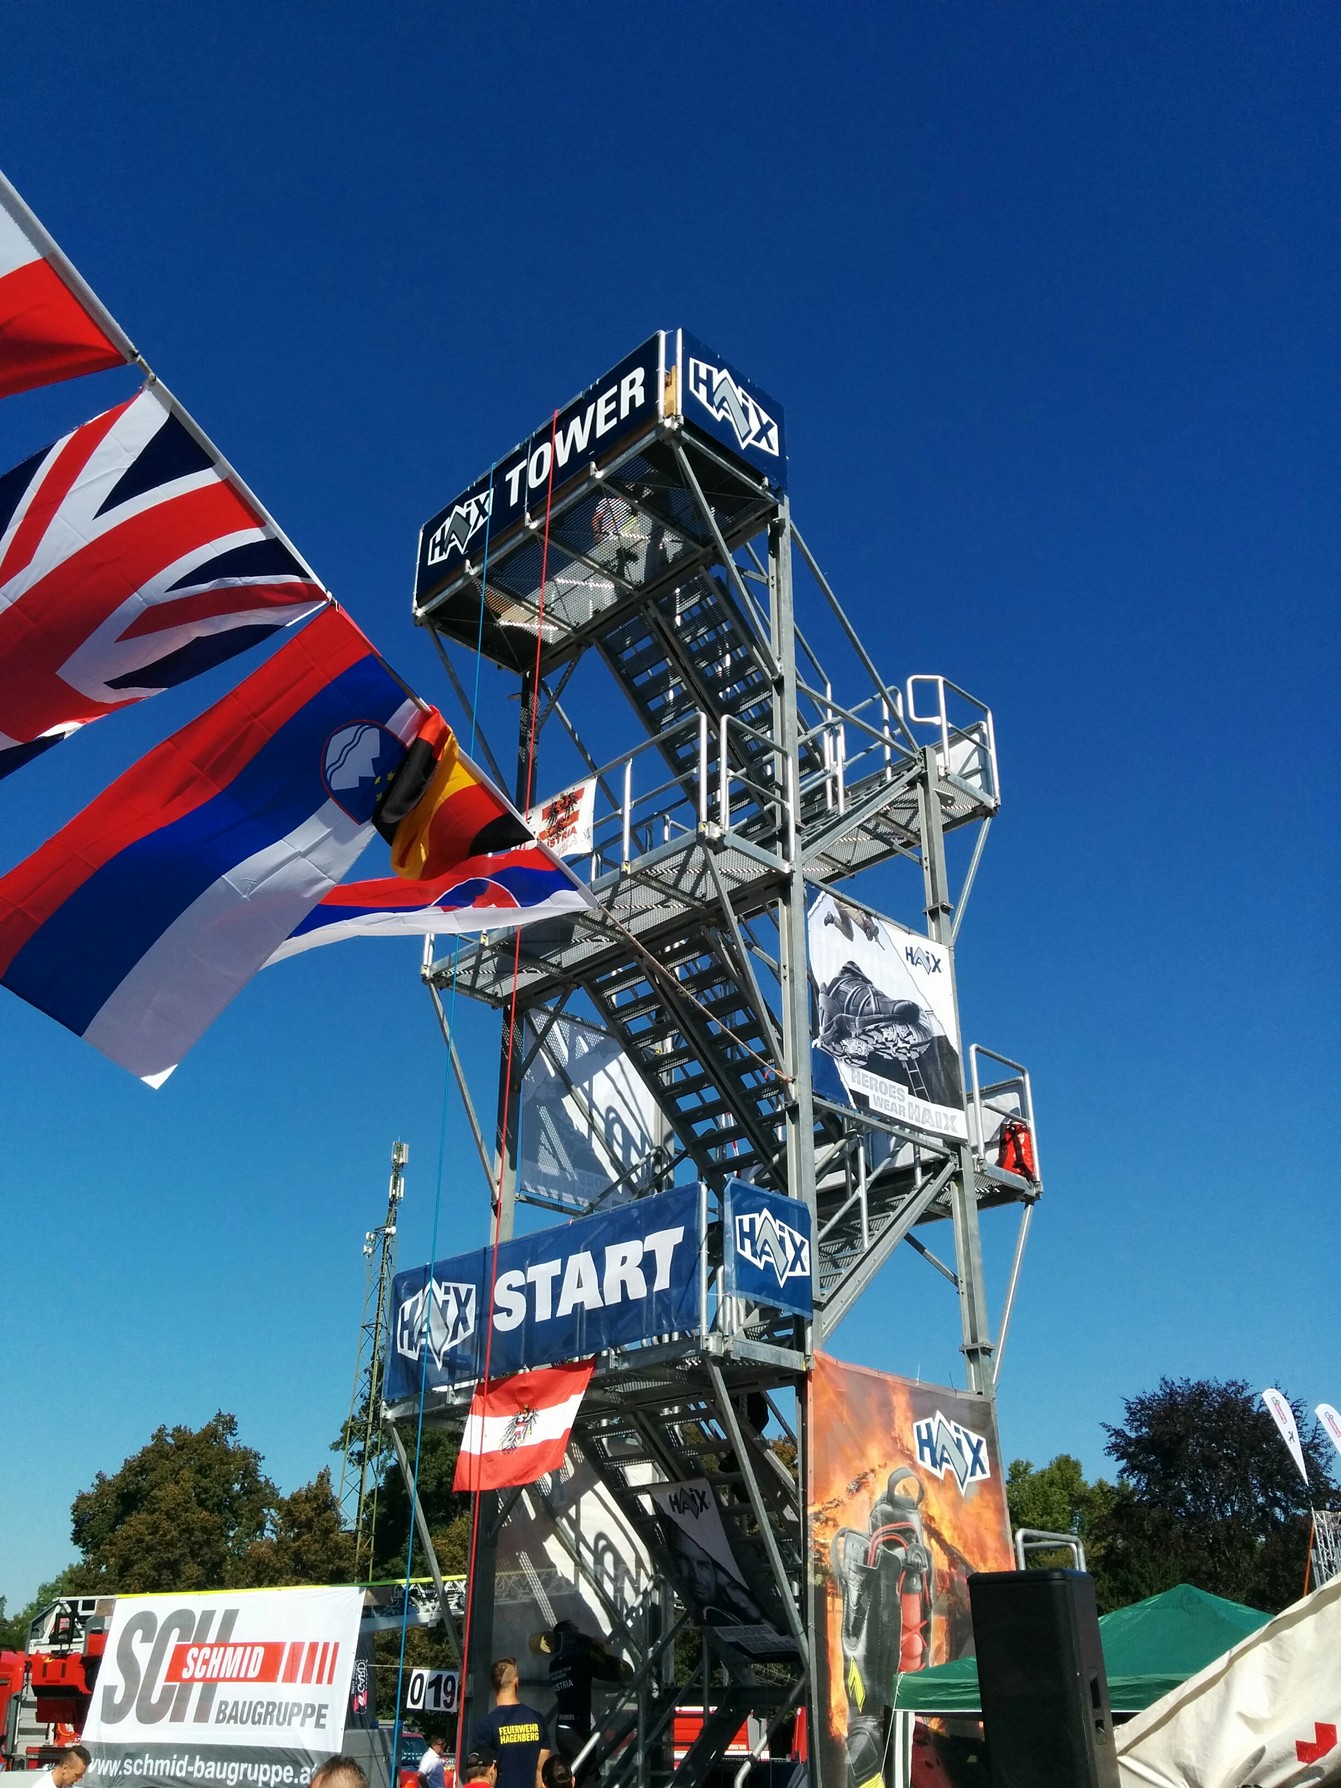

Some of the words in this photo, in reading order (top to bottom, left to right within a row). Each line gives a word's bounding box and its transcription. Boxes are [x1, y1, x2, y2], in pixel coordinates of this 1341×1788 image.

[505, 366, 645, 507] TOWER
[850, 1068, 906, 1103] HEROES
[872, 1093, 906, 1117] WEAR
[907, 1101, 959, 1134] HAIX
[492, 1226, 685, 1331] START
[101, 1608, 240, 1726] SCH
[181, 1645, 265, 1679] SCHMID
[214, 1700, 329, 1730] BAUGRUPPE
[499, 1723, 539, 1736] FEUERWEHR
[500, 1732, 539, 1745] HAGENBERG
